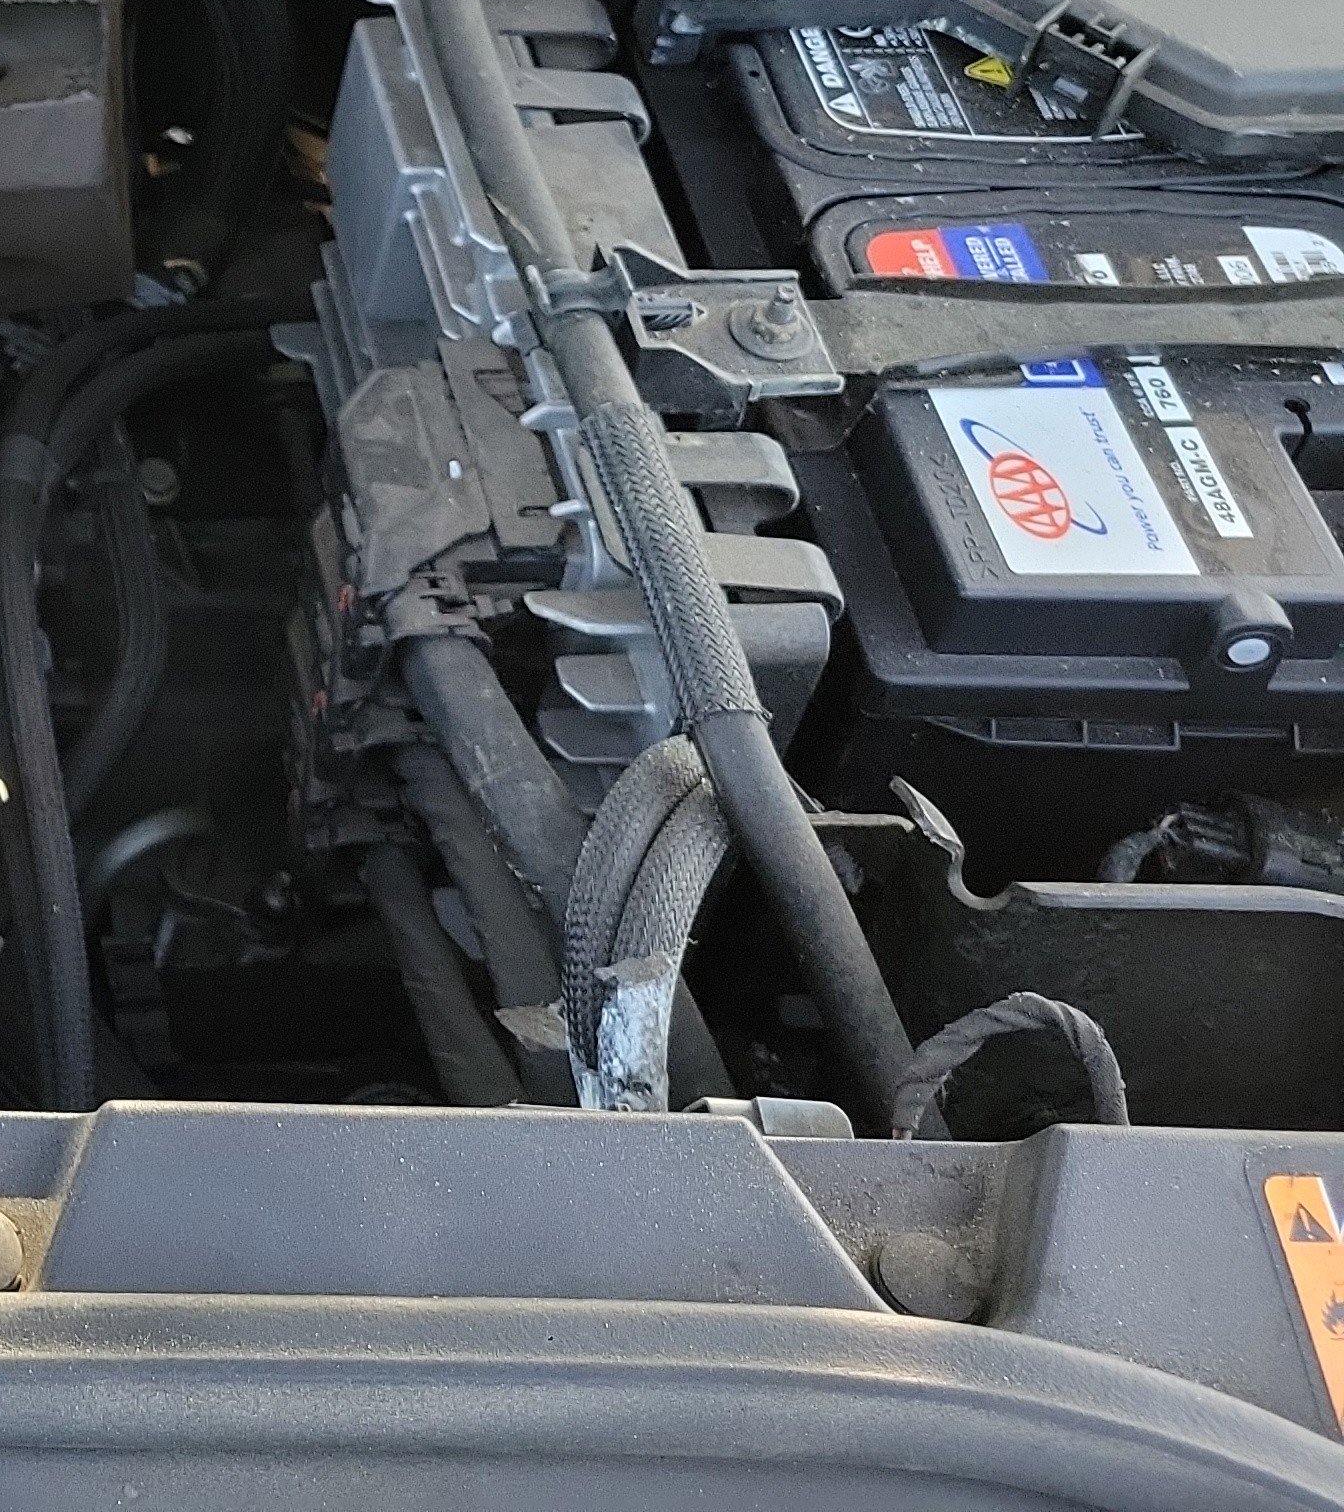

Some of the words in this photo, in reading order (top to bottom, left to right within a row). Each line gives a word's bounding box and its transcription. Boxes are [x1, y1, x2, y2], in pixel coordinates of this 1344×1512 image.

[799, 27, 844, 89] DANGE
[965, 236, 999, 280] VERED
[1148, 377, 1178, 411] 760
[1080, 410, 1110, 445] trust
[1102, 448, 1123, 472] can
[1180, 438, 1236, 524] 48AGM-C
[989, 451, 1071, 540] AAA
[1115, 474, 1144, 503] you
[1130, 504, 1164, 552] Power
